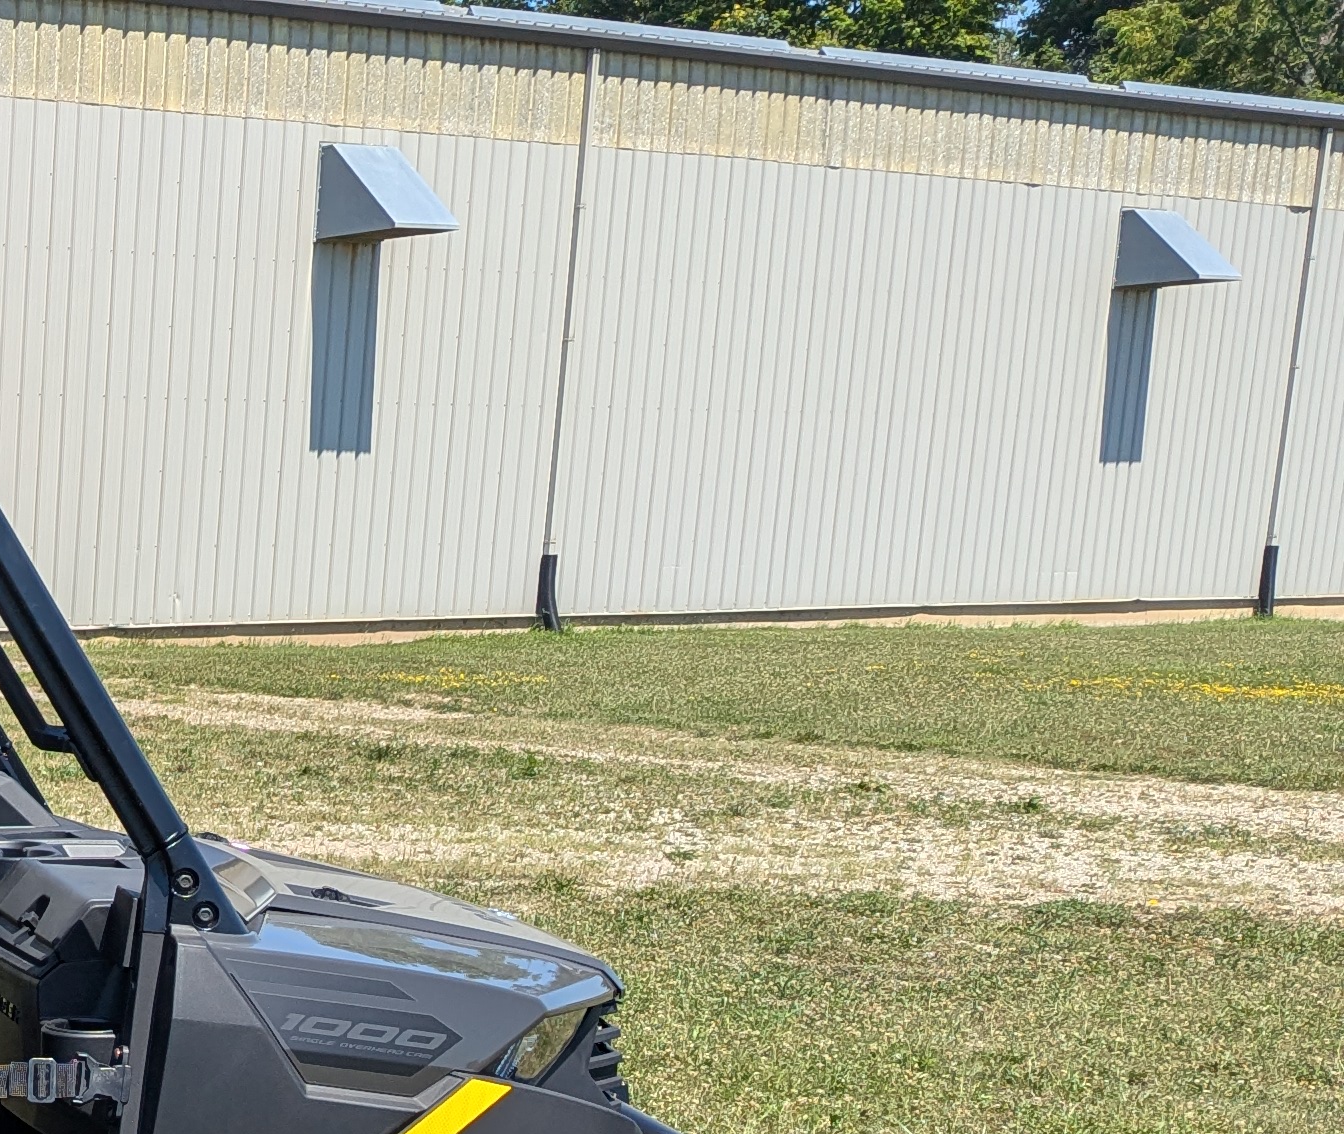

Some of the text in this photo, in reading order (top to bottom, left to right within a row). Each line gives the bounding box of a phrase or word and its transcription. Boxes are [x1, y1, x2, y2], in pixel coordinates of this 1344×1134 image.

[280, 1013, 447, 1050] 1000
[289, 1035, 434, 1060] SINGLE OVERHEAD CAM
